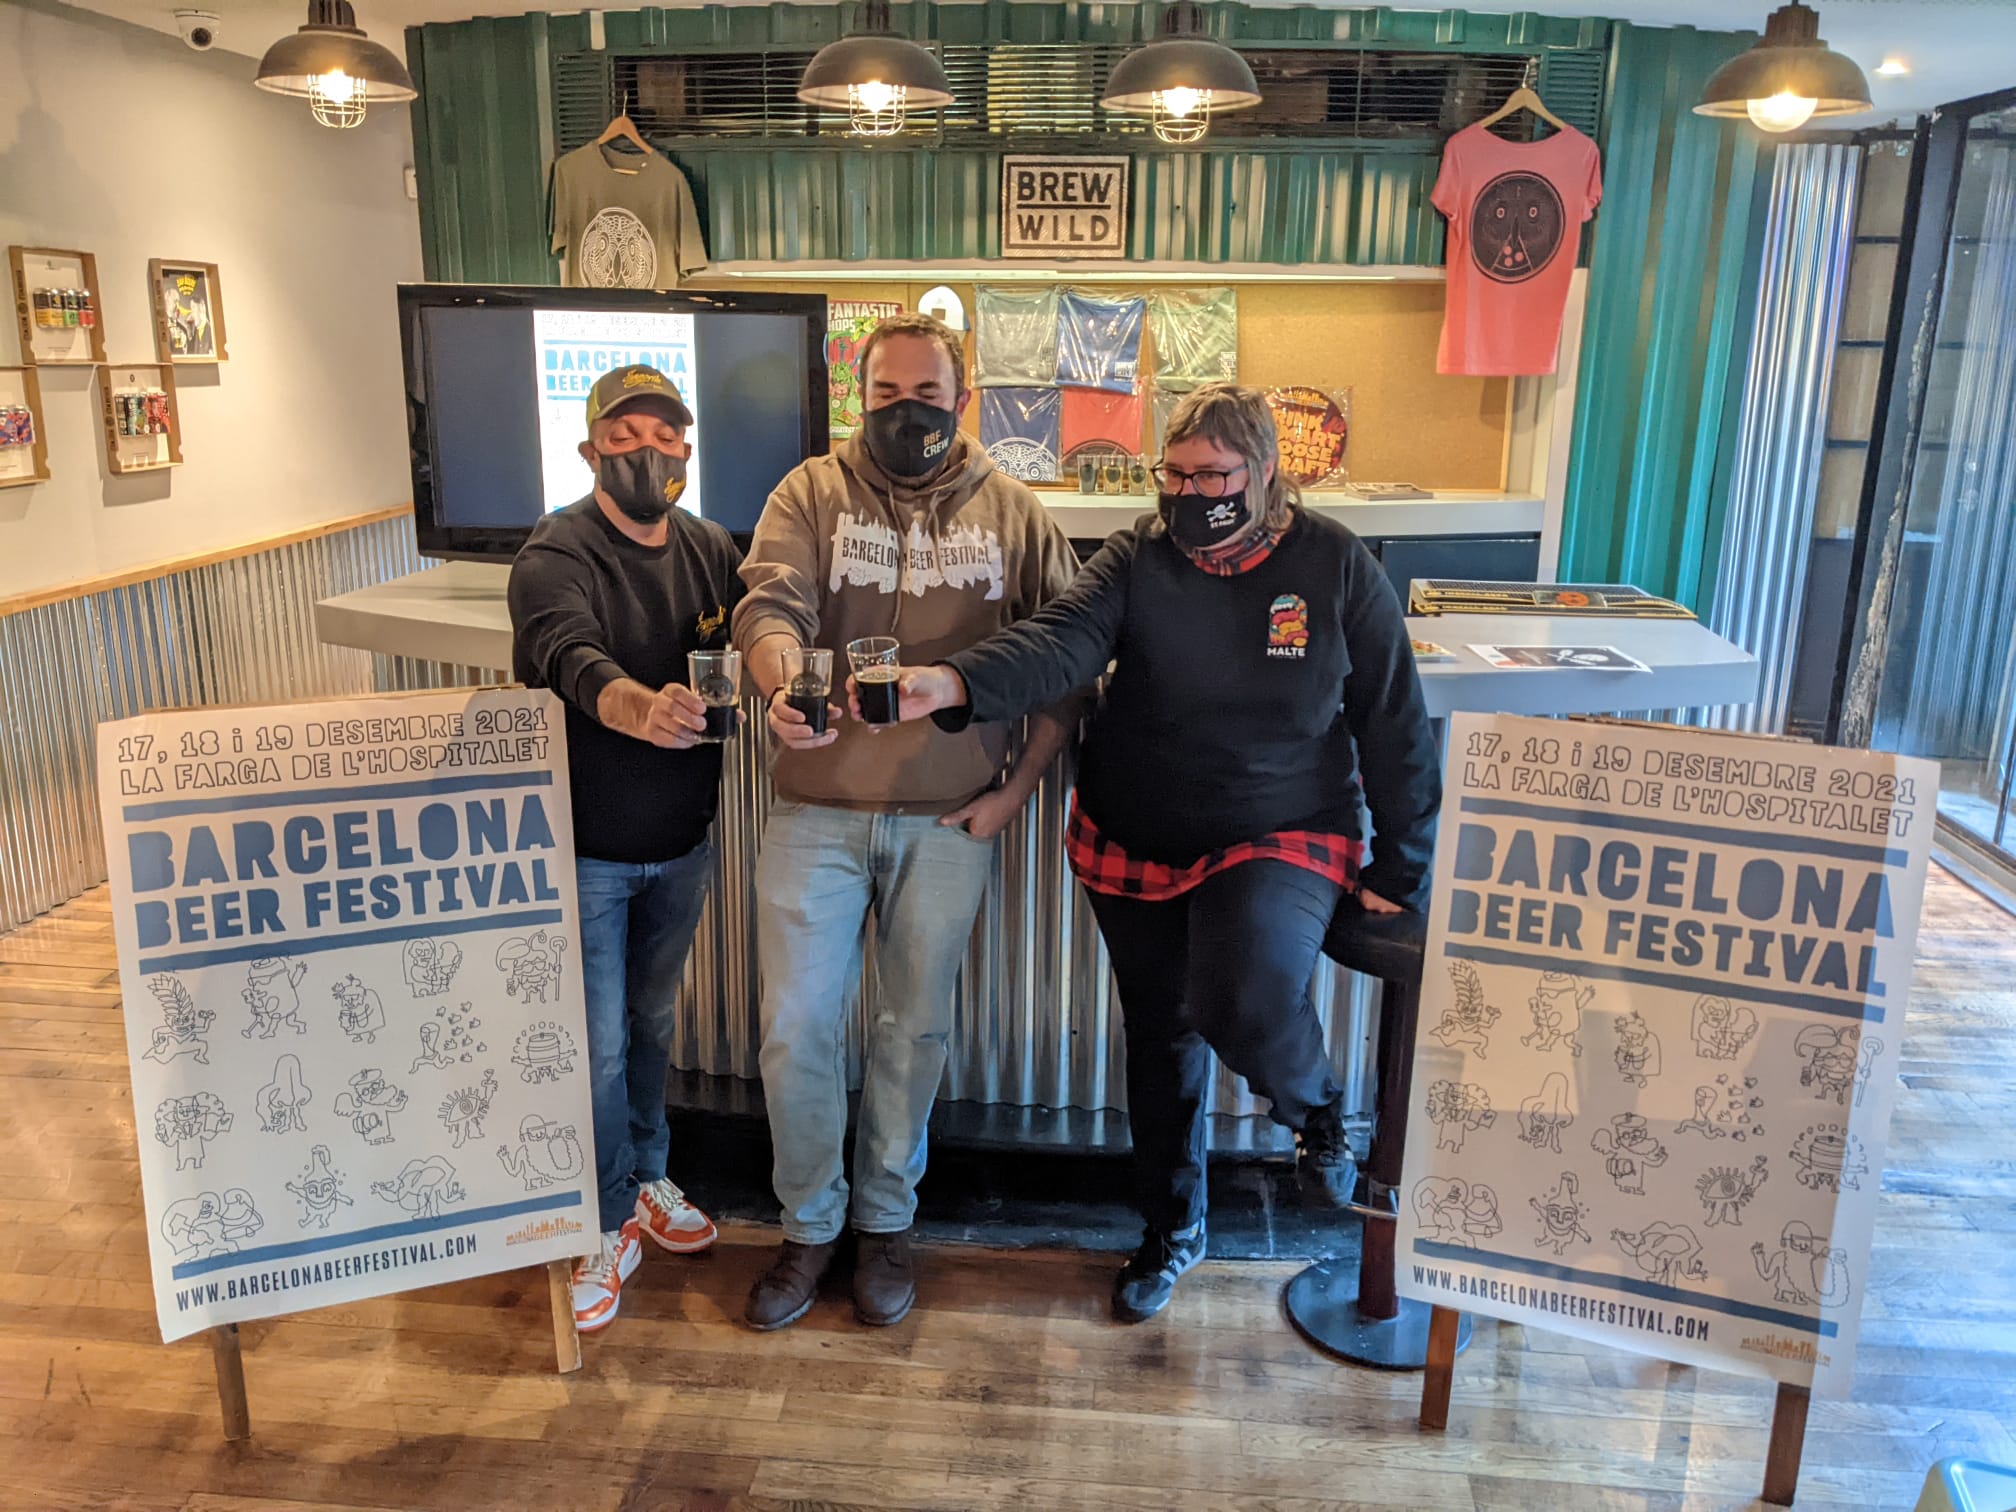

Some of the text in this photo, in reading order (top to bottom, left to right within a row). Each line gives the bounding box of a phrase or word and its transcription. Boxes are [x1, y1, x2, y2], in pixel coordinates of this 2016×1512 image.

[1017, 171, 1113, 203] BREW
[1017, 214, 1110, 242] WILD
[544, 349, 687, 373] BARCELONA
[546, 375, 592, 391] BEER
[1272, 408, 1325, 433] RINK
[923, 429, 942, 447] BBF
[923, 436, 950, 458] CREW
[1278, 440, 1333, 463] OOSE
[1278, 455, 1330, 477] RAFT
[909, 548, 934, 571] BEER
[1266, 647, 1306, 657] MALTE
[118, 707, 549, 764] 17, 18 i 19 DESEMBRE 2021
[121, 736, 550, 795] LA FARGA DE L'HOSPITALET
[1466, 731, 1916, 806] 17, 18 i 19 DESEMBRE 2021
[1463, 761, 1913, 837] LA FARGA DE L'HOSPITALET
[126, 793, 556, 893] BARCELONA
[1453, 822, 1896, 939] BARCELONA
[135, 856, 560, 949] BEER FESTIVAL
[1448, 888, 1888, 998] BEER FESTIVAL
[176, 1233, 478, 1312] WWW.BARCELONABEERFESTIVAL.COM
[1413, 1264, 1710, 1341] WWW.BARCELONABEERFESTIVAL.COM
